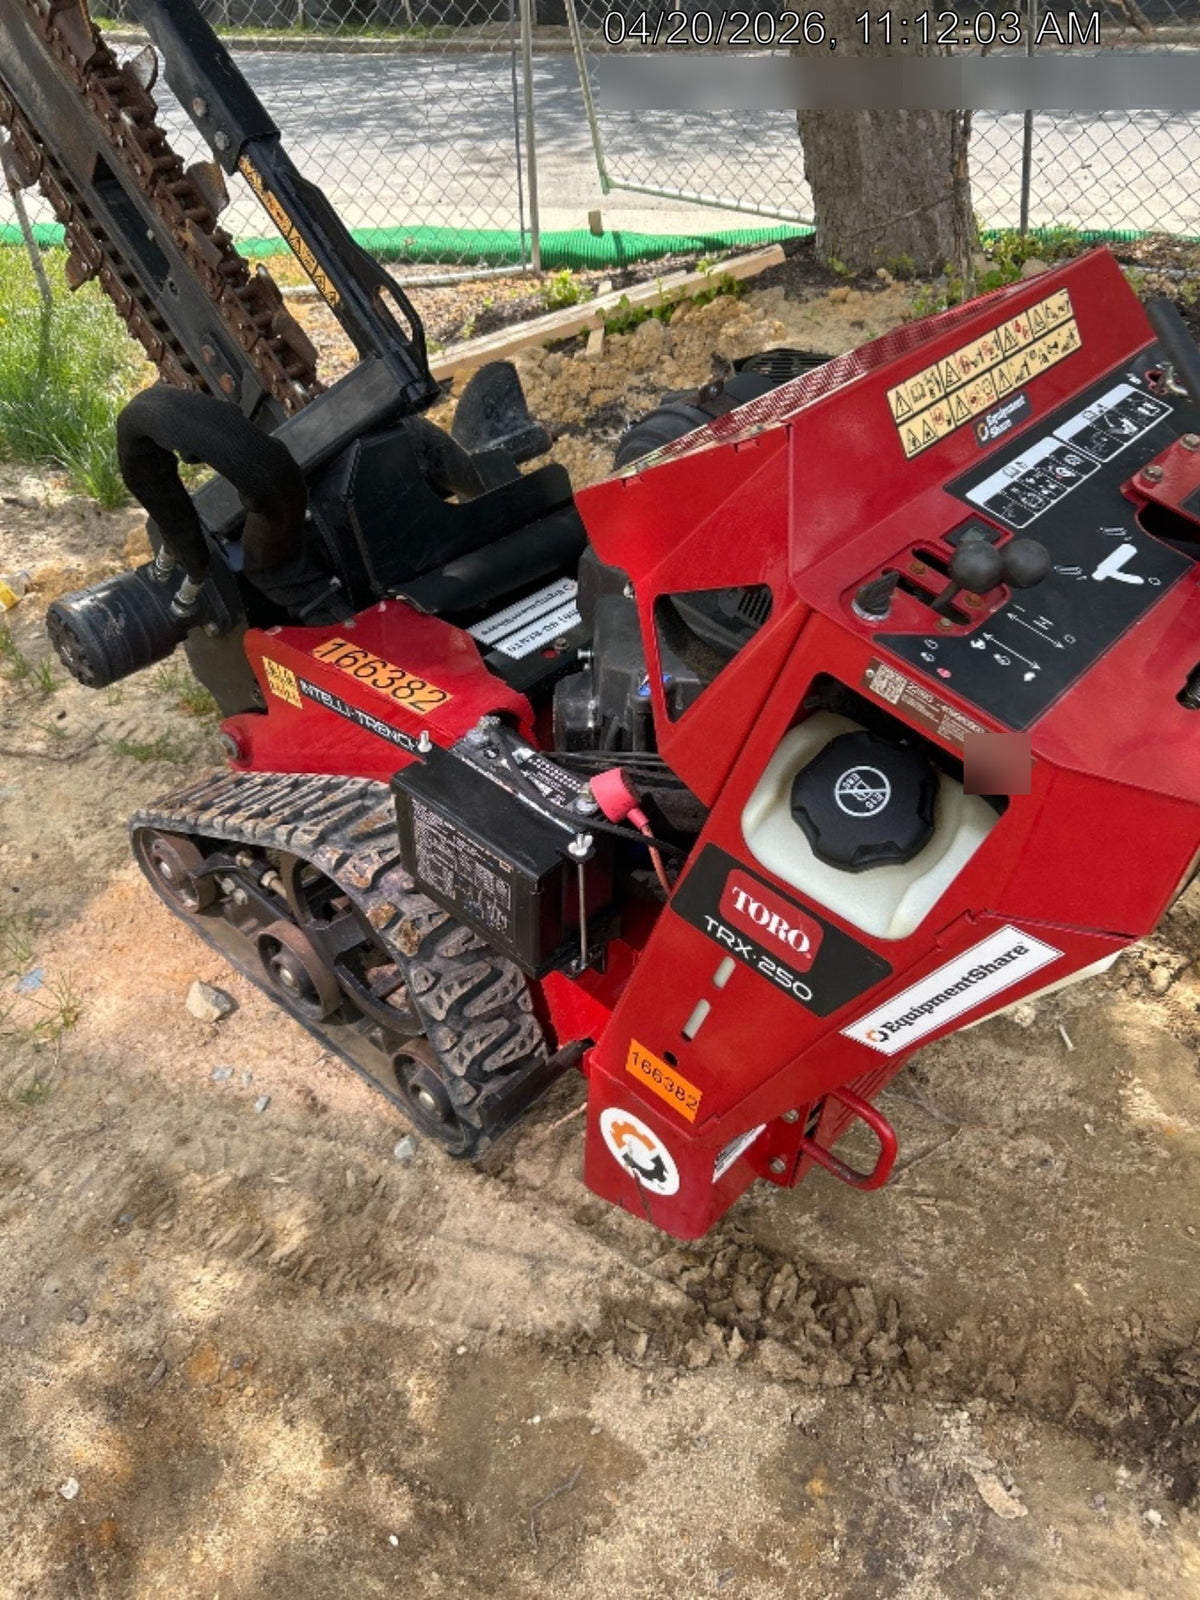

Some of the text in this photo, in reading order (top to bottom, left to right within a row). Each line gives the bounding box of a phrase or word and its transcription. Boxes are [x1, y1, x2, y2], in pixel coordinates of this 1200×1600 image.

[319, 642, 447, 711] 166382
[731, 886, 811, 959] TORO
[881, 943, 1030, 1034] EquipmentShare
[632, 1052, 698, 1112] 166382
